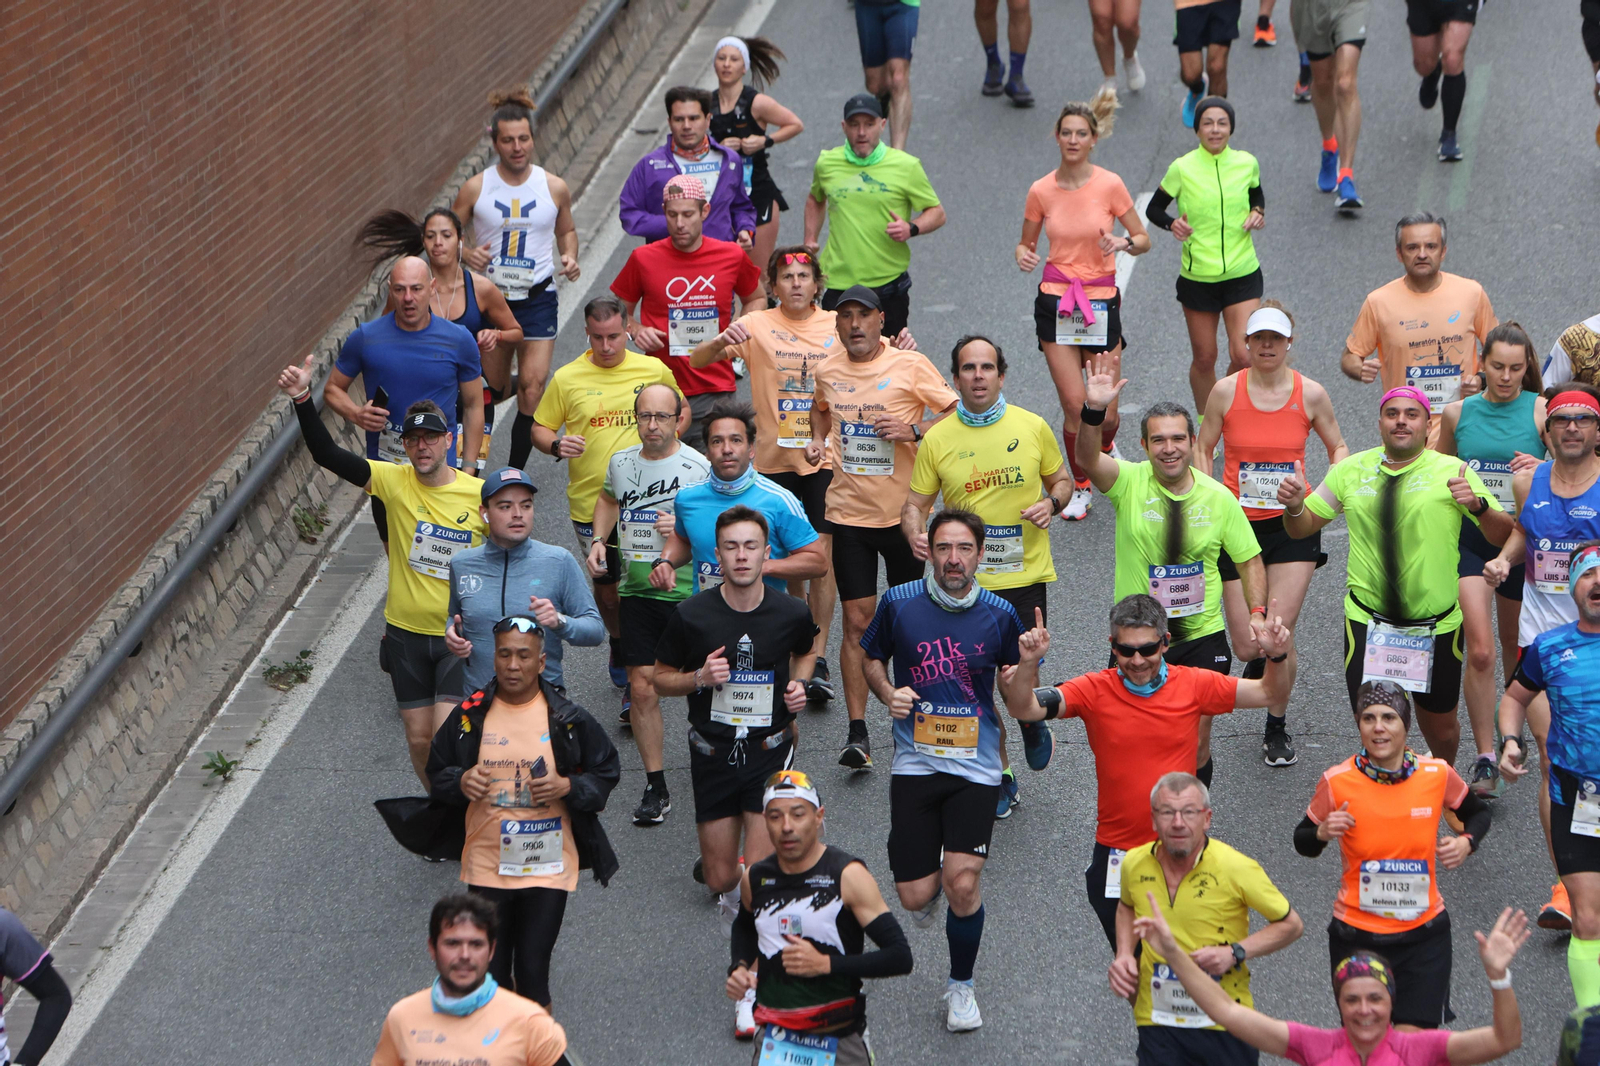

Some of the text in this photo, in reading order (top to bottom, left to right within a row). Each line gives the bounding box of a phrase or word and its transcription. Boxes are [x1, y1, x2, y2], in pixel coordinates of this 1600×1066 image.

[688, 164, 715, 173] ZURICH
[504, 257, 531, 267] ZURICH
[687, 310, 714, 319] ZURICH
[686, 326, 705, 334] 9954
[775, 350, 803, 359] Maratón
[1424, 367, 1455, 376] ZURICH
[1424, 384, 1442, 392] 9511
[834, 402, 858, 411] Maratón
[856, 443, 876, 452] 8636
[843, 454, 892, 464] PAULO PORTUGAL
[1259, 462, 1290, 471] ZURICH
[983, 465, 1021, 478] MARATON
[1256, 477, 1279, 486] 10240
[435, 528, 468, 541] ZURICH
[633, 530, 652, 538] 8339
[986, 528, 1017, 536] ZURICH
[432, 543, 452, 556] 9456
[985, 544, 1005, 553] 8623
[419, 555, 444, 567] Antonio
[1170, 565, 1200, 576] ZURICH
[1544, 573, 1560, 581] LUIS
[1169, 583, 1190, 594] 6898
[1171, 598, 1190, 606] DAVID
[1389, 637, 1423, 649] ZURICH
[917, 636, 965, 666] 21k
[1386, 655, 1408, 665] 6863
[909, 658, 954, 685] BDO
[1385, 669, 1407, 678] OLIVIA
[735, 674, 769, 682] ZURICH
[732, 691, 754, 701] 9974
[732, 706, 753, 714] VINCH
[936, 706, 972, 715] ZURICH
[935, 723, 958, 733] 6102
[936, 737, 956, 746] RAUL
[483, 759, 515, 768] Maratón
[523, 820, 556, 832] ZURICH
[522, 841, 544, 851] 9908
[1384, 862, 1422, 872] ZURICH
[1381, 882, 1410, 892] 10133
[788, 1034, 828, 1050] ZURICH
[782, 1052, 812, 1066] 11030
